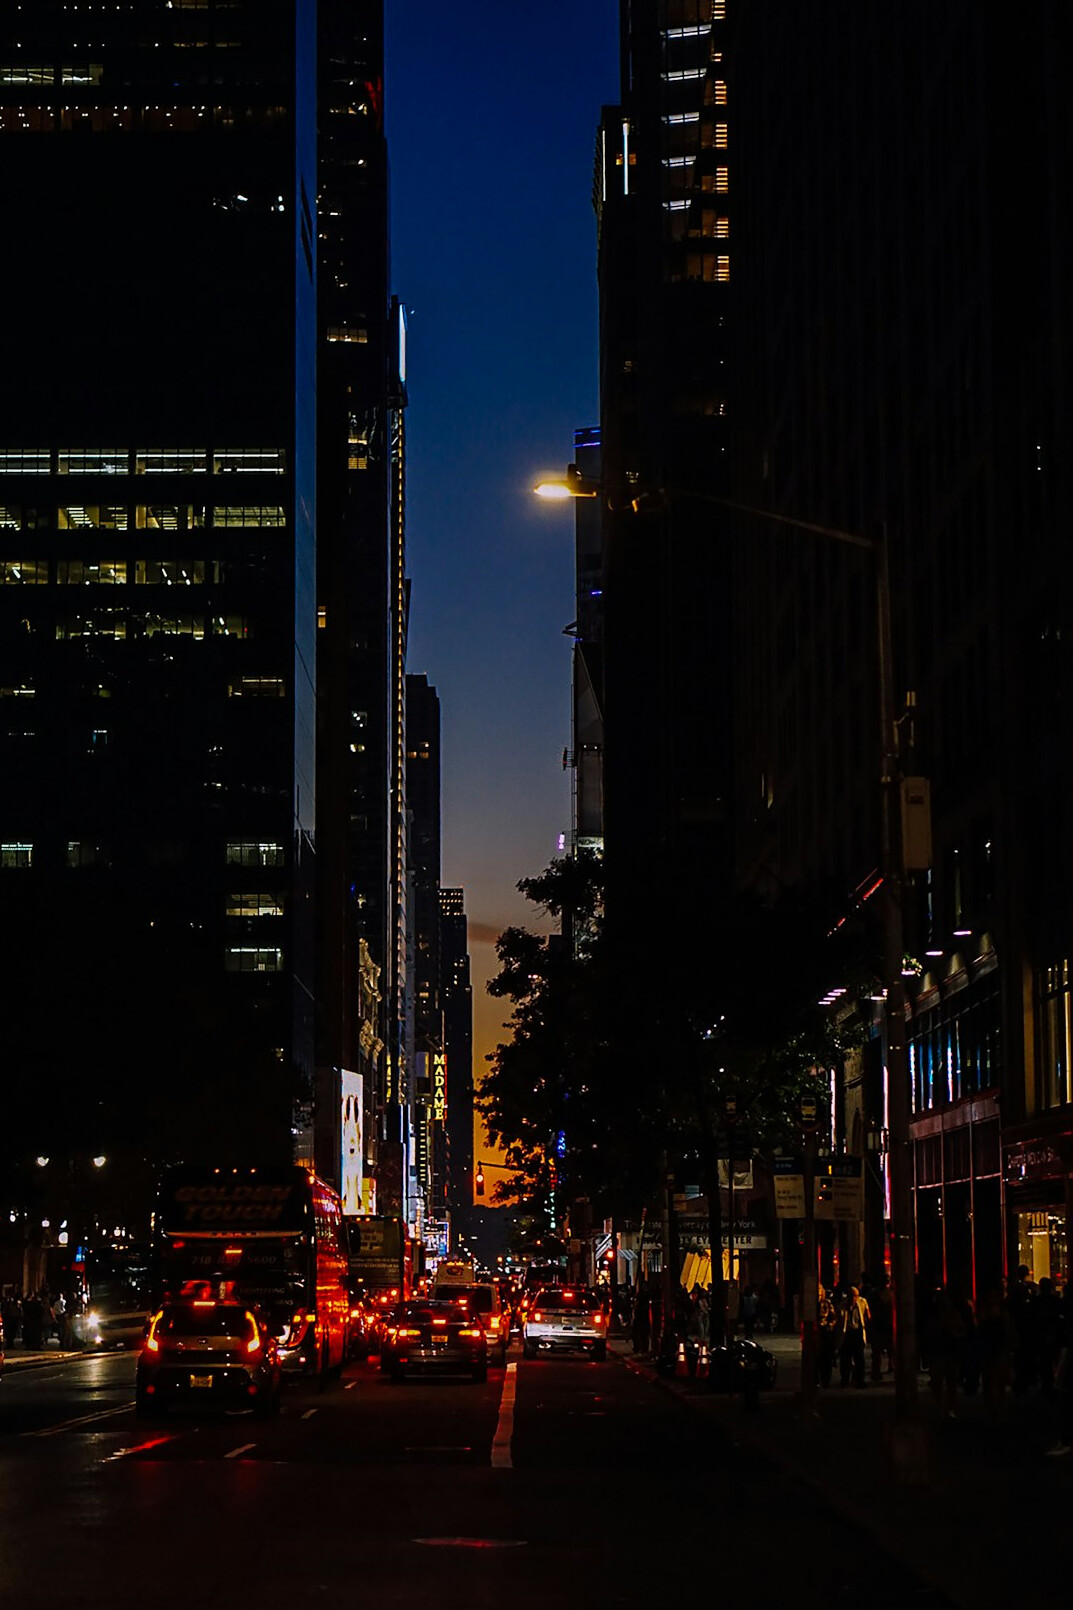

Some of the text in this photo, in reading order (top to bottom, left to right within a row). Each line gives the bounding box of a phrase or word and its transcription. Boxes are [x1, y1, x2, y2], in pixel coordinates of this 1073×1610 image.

[433, 1053, 446, 1120] MADAME
[173, 1184, 293, 1202] GOLDEN
[184, 1203, 283, 1221] TOUCH
